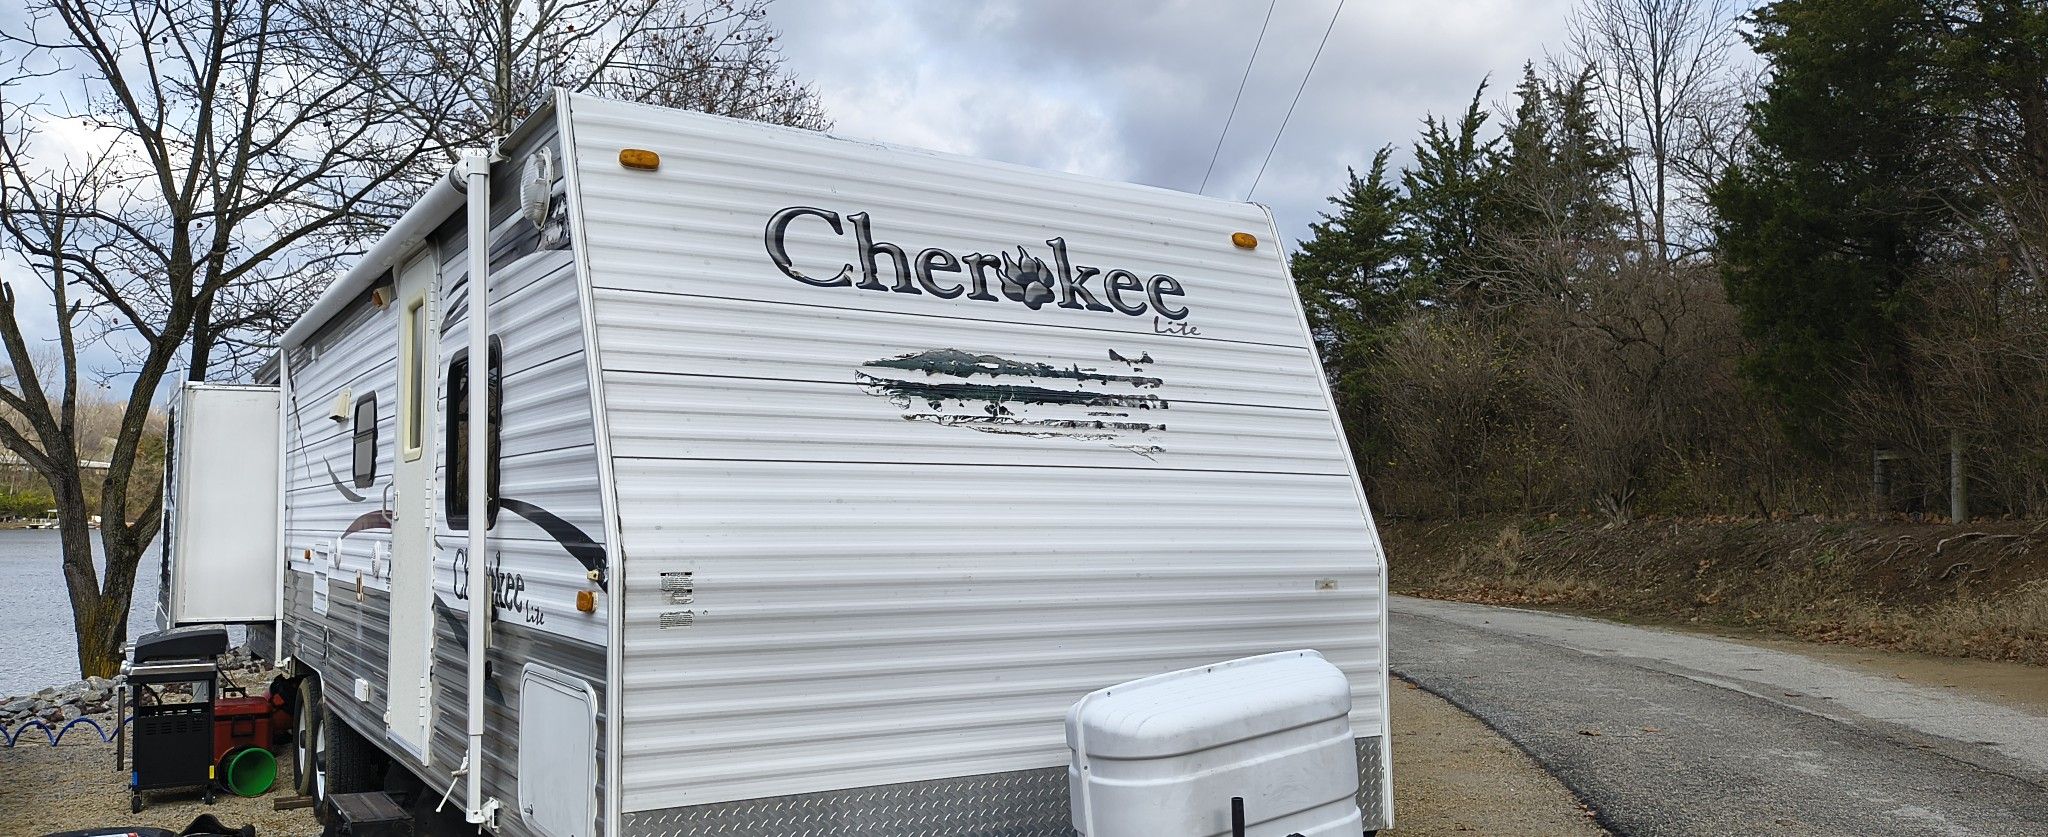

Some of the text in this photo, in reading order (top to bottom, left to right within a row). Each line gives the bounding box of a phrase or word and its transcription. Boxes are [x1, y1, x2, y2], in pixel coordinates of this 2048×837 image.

[764, 206, 1189, 321] Cherokee
[1153, 316, 1201, 335] Lite
[453, 548, 525, 613] Ckee
[525, 600, 545, 626] Lite
